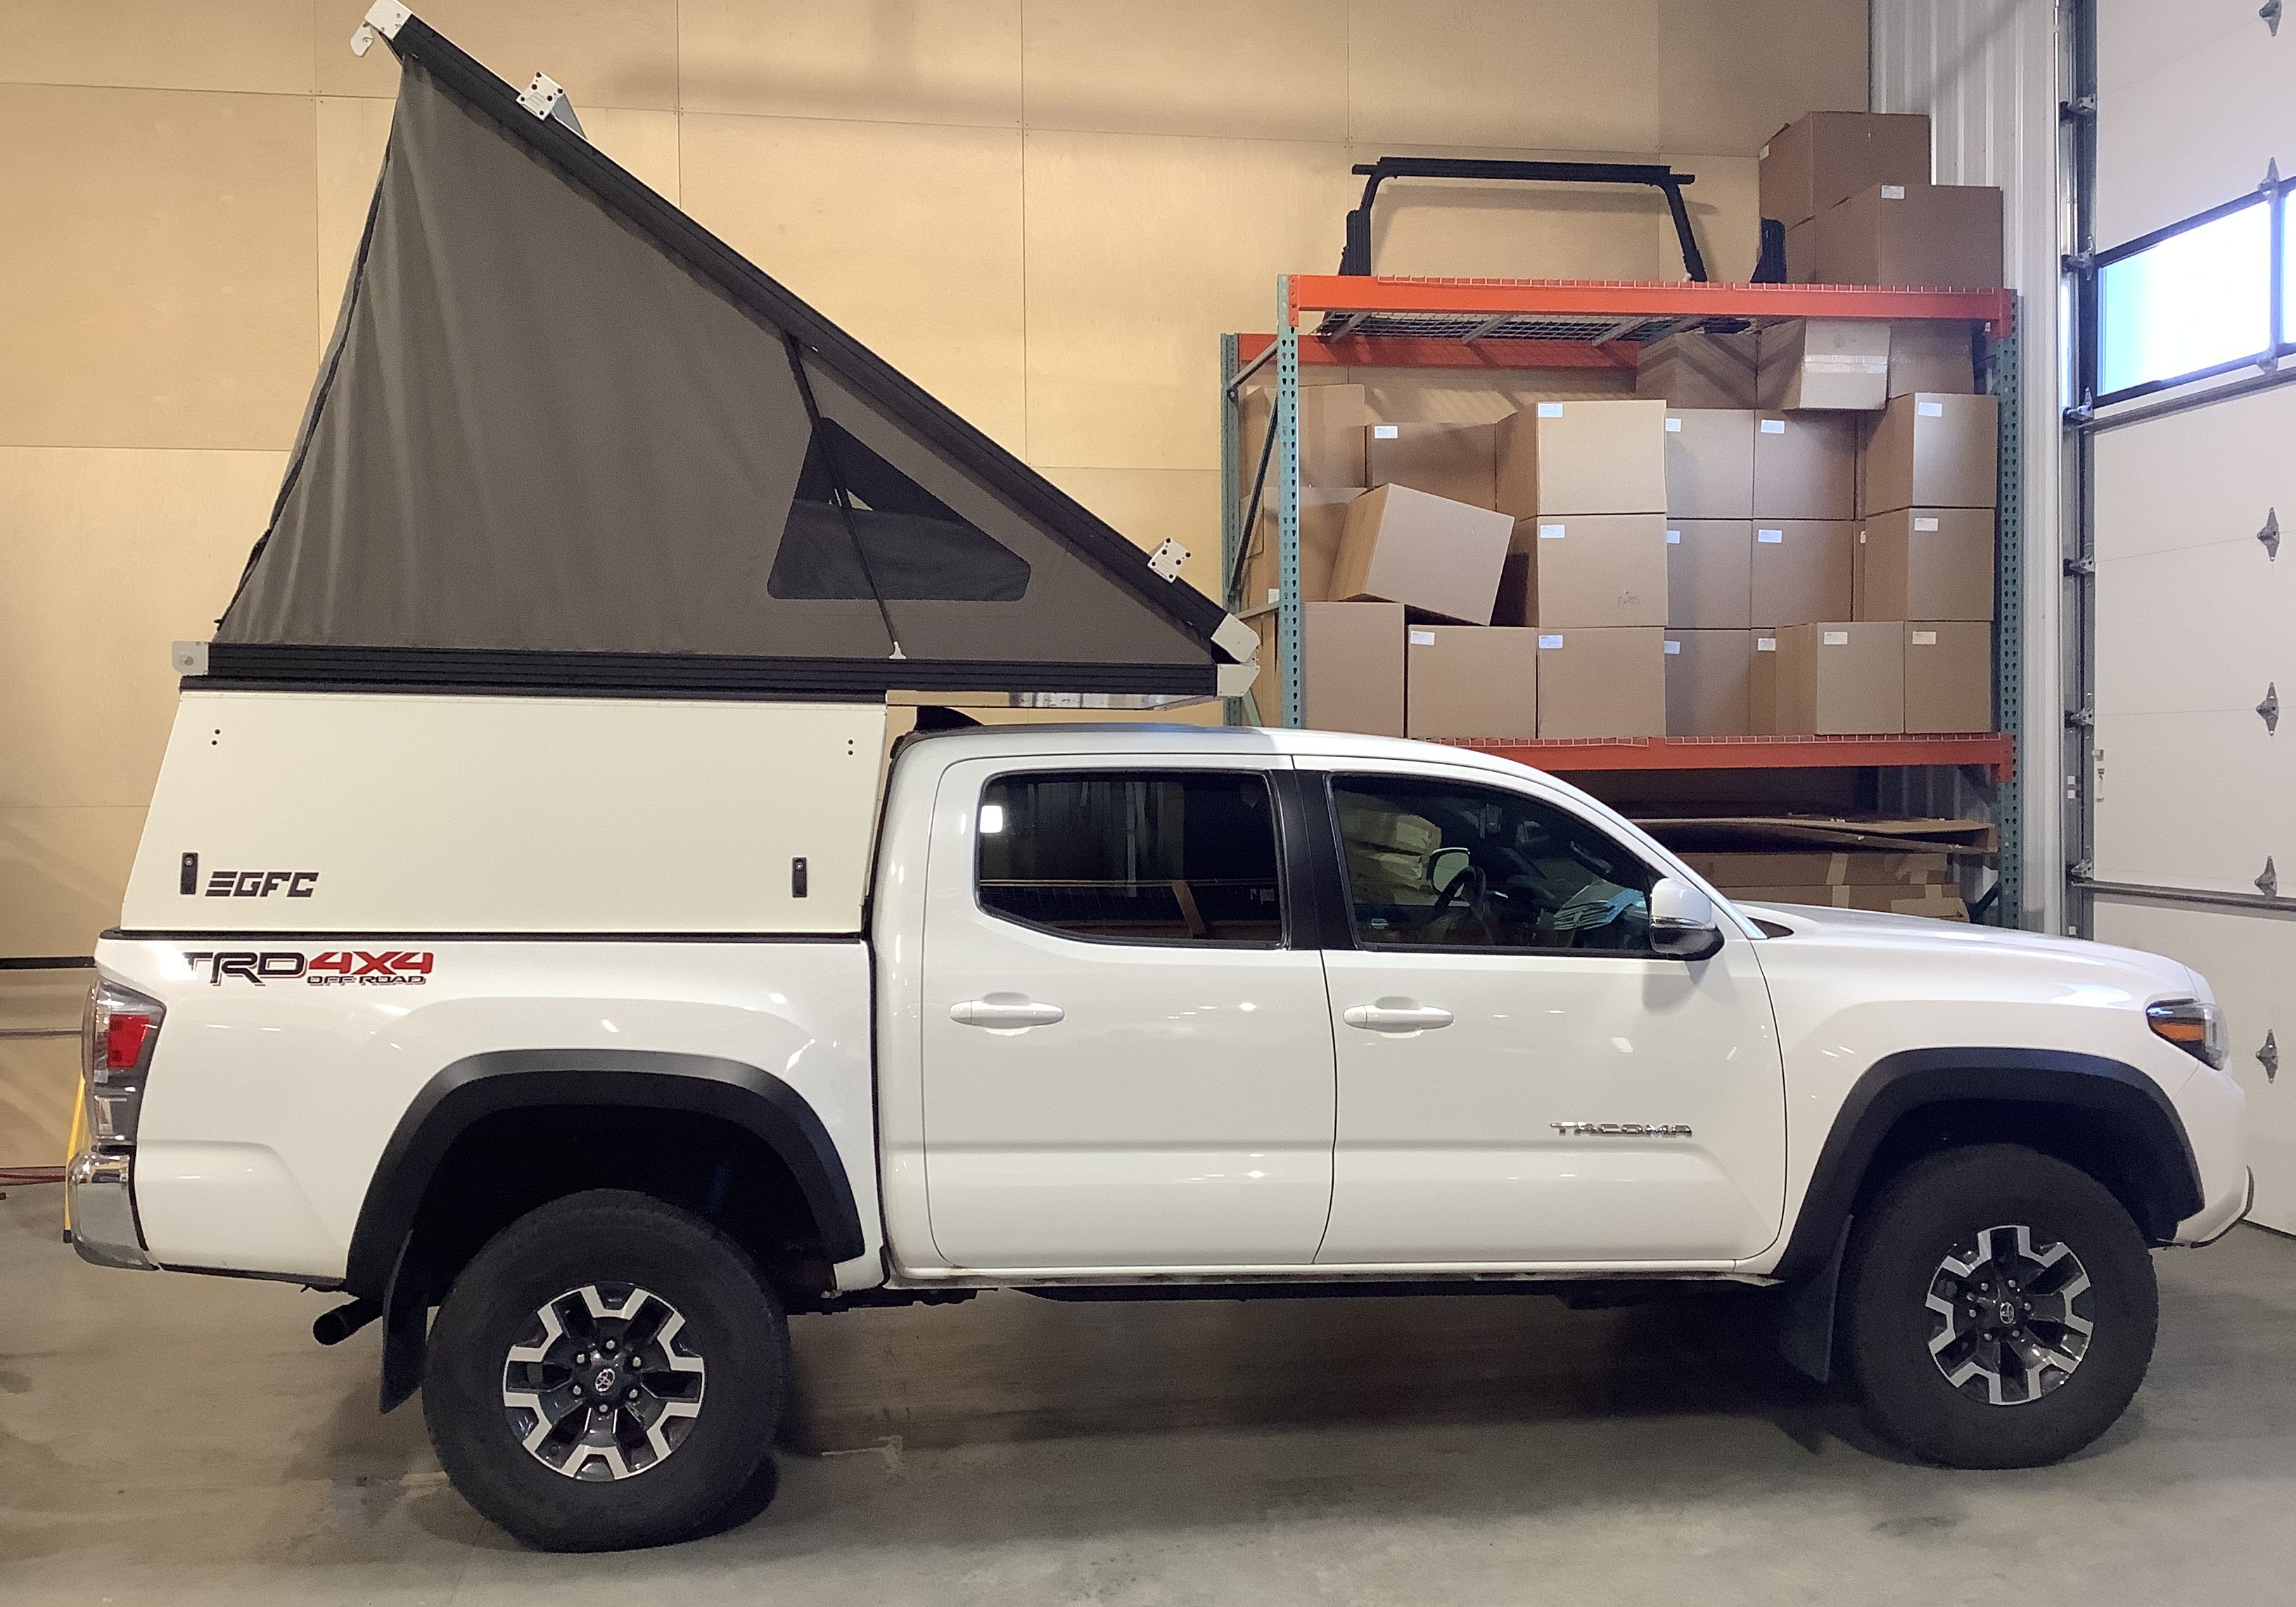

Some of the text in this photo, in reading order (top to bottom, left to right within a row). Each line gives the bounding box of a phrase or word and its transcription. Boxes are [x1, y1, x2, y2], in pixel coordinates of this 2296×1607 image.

[181, 951, 307, 986] TRD
[307, 974, 426, 986] OFF ROAD
[1549, 1121, 1692, 1138] TACOMA
